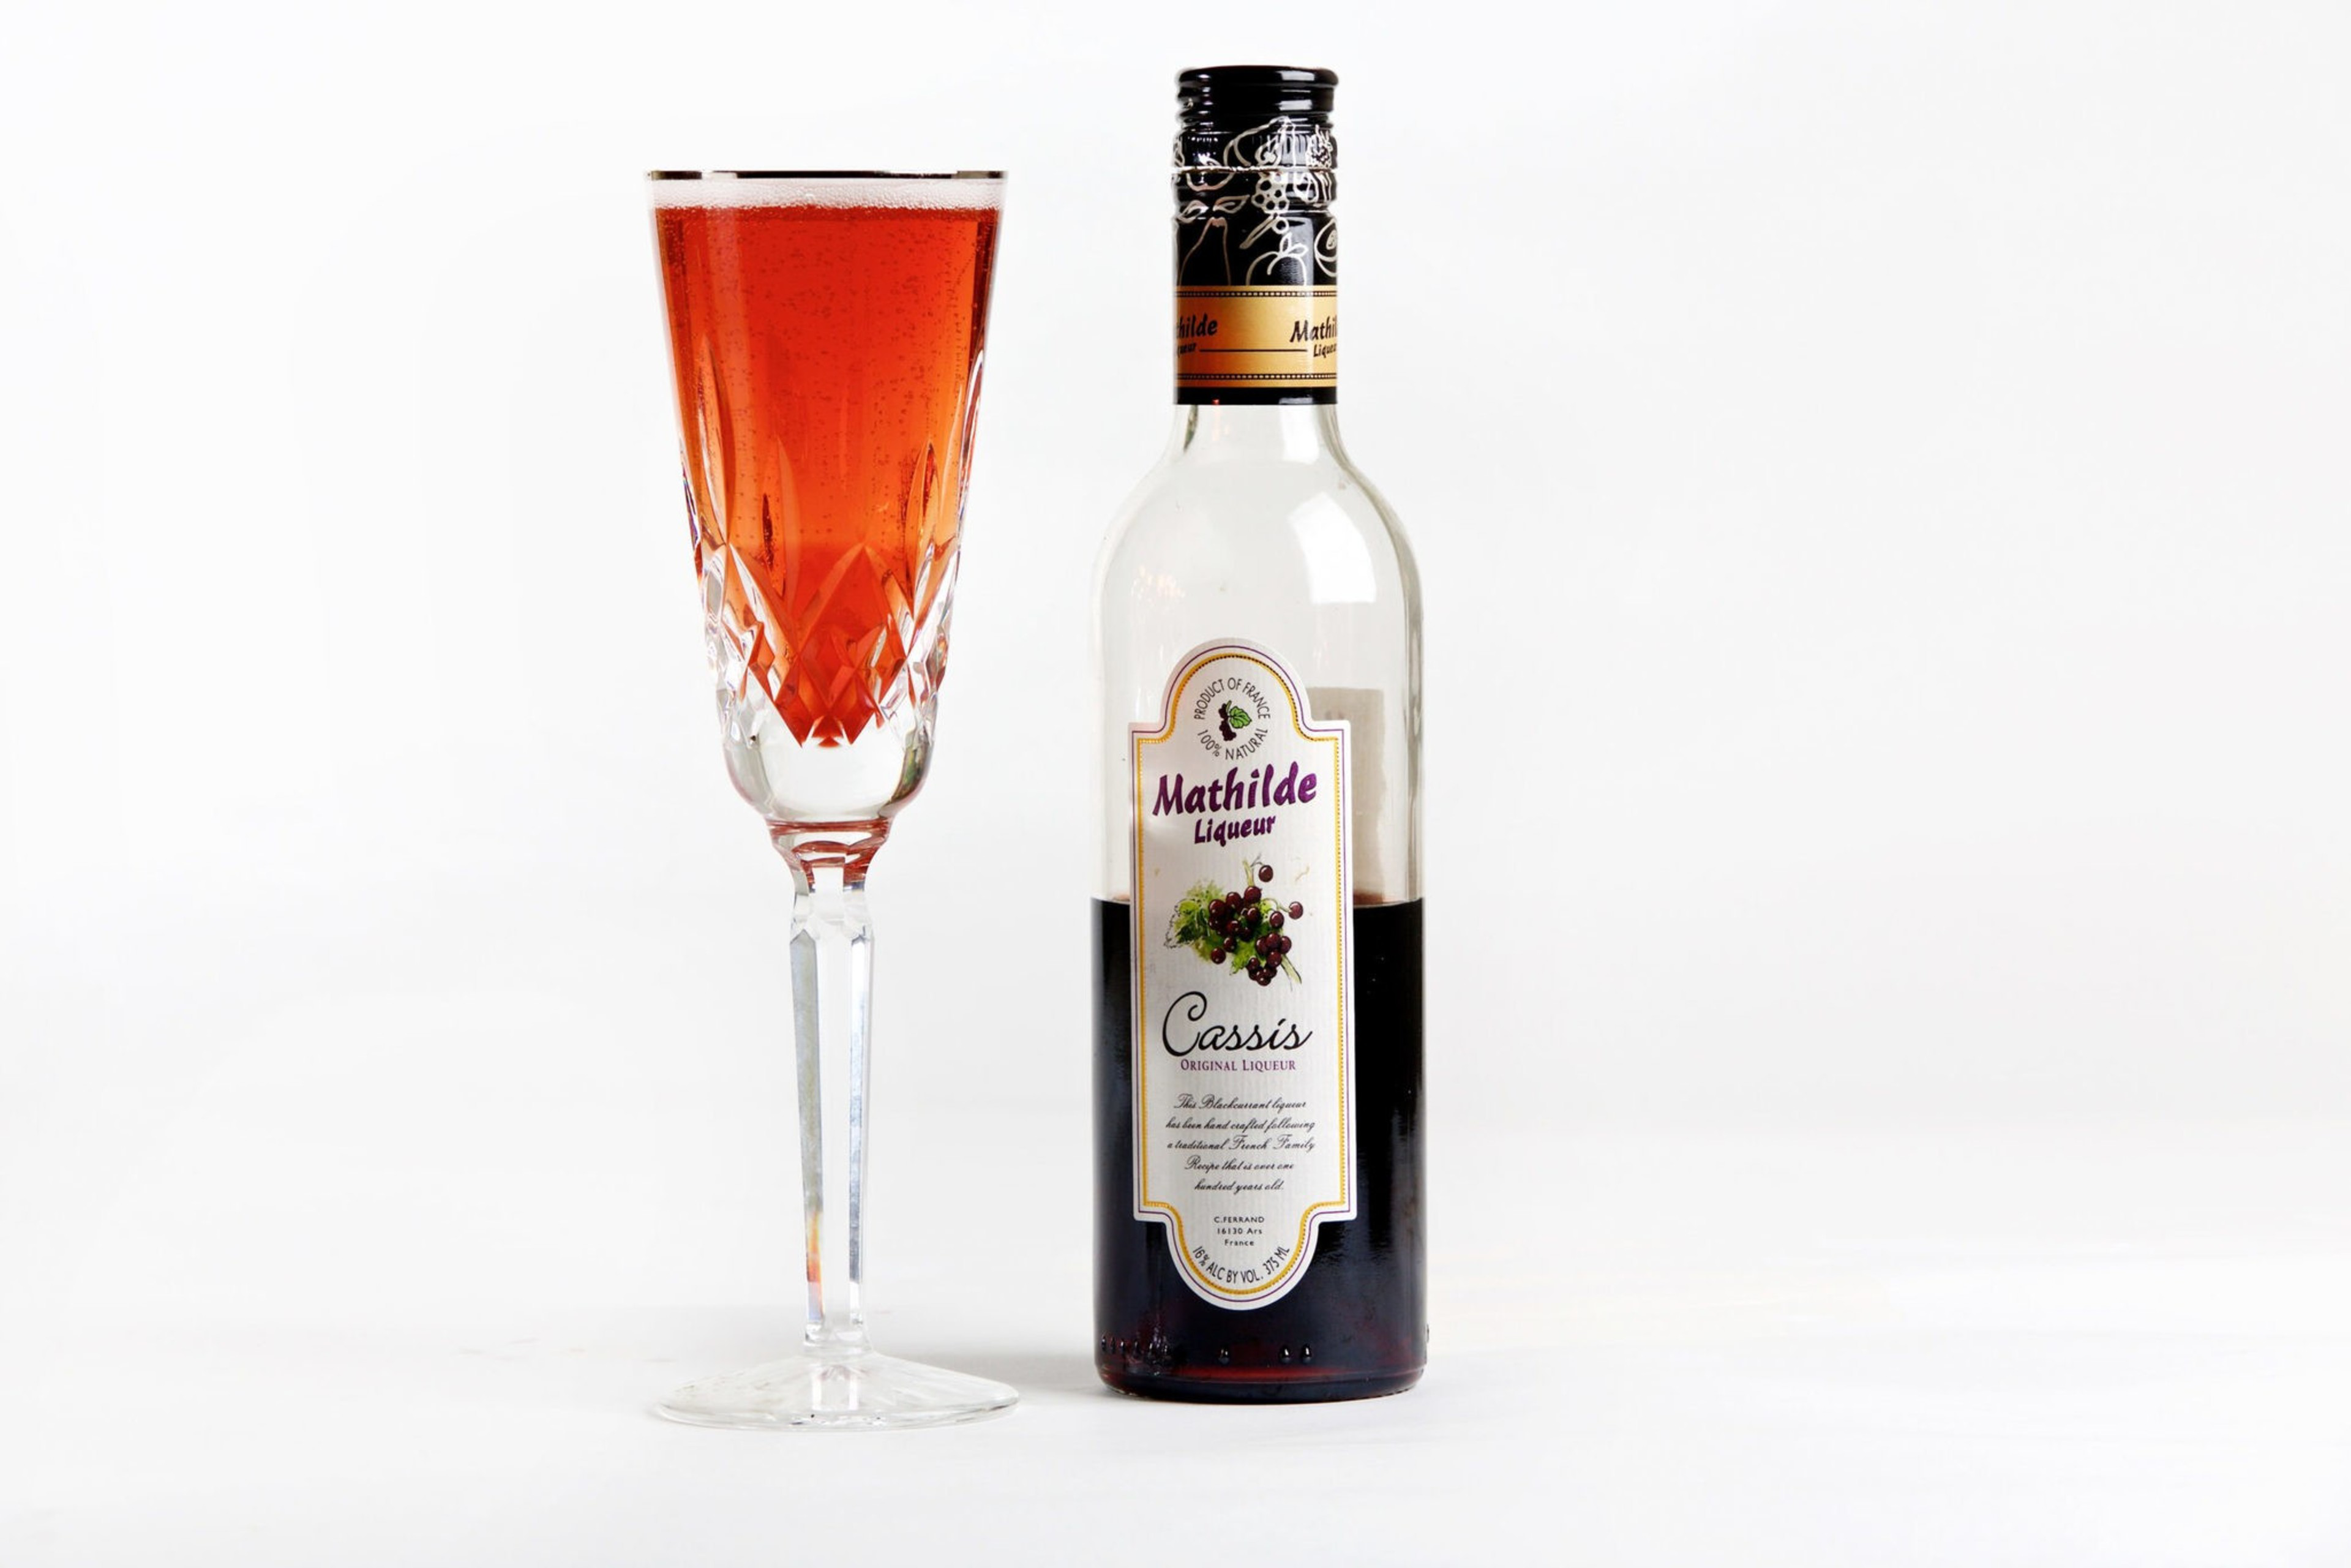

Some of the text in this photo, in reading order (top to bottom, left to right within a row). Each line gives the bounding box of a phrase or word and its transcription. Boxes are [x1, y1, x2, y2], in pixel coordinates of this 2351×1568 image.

[1194, 677, 1270, 720] PRODUCT OF FRANCE
[1198, 729, 1268, 760] 100% NATURAL
[1152, 761, 1317, 816] Mathilde
[1194, 816, 1276, 847] Liqueur
[1162, 991, 1313, 1057] Cassis
[1180, 1059, 1296, 1072] ORIGINAL LIQUEUR
[1174, 1093, 1306, 1113] This Blackcurrant liqueur
[1166, 1117, 1315, 1133] has been hand crafted following
[1175, 1138, 1229, 1150] traditional
[1228, 1135, 1272, 1150] French
[1273, 1134, 1315, 1153] Family
[1184, 1155, 1220, 1173] Recipe
[1221, 1157, 1244, 1169] that
[1194, 1178, 1236, 1190] hundred
[1235, 1184, 1263, 1195] years
[1193, 1246, 1290, 1283] 16% ALC BY VOL. 375 ML
